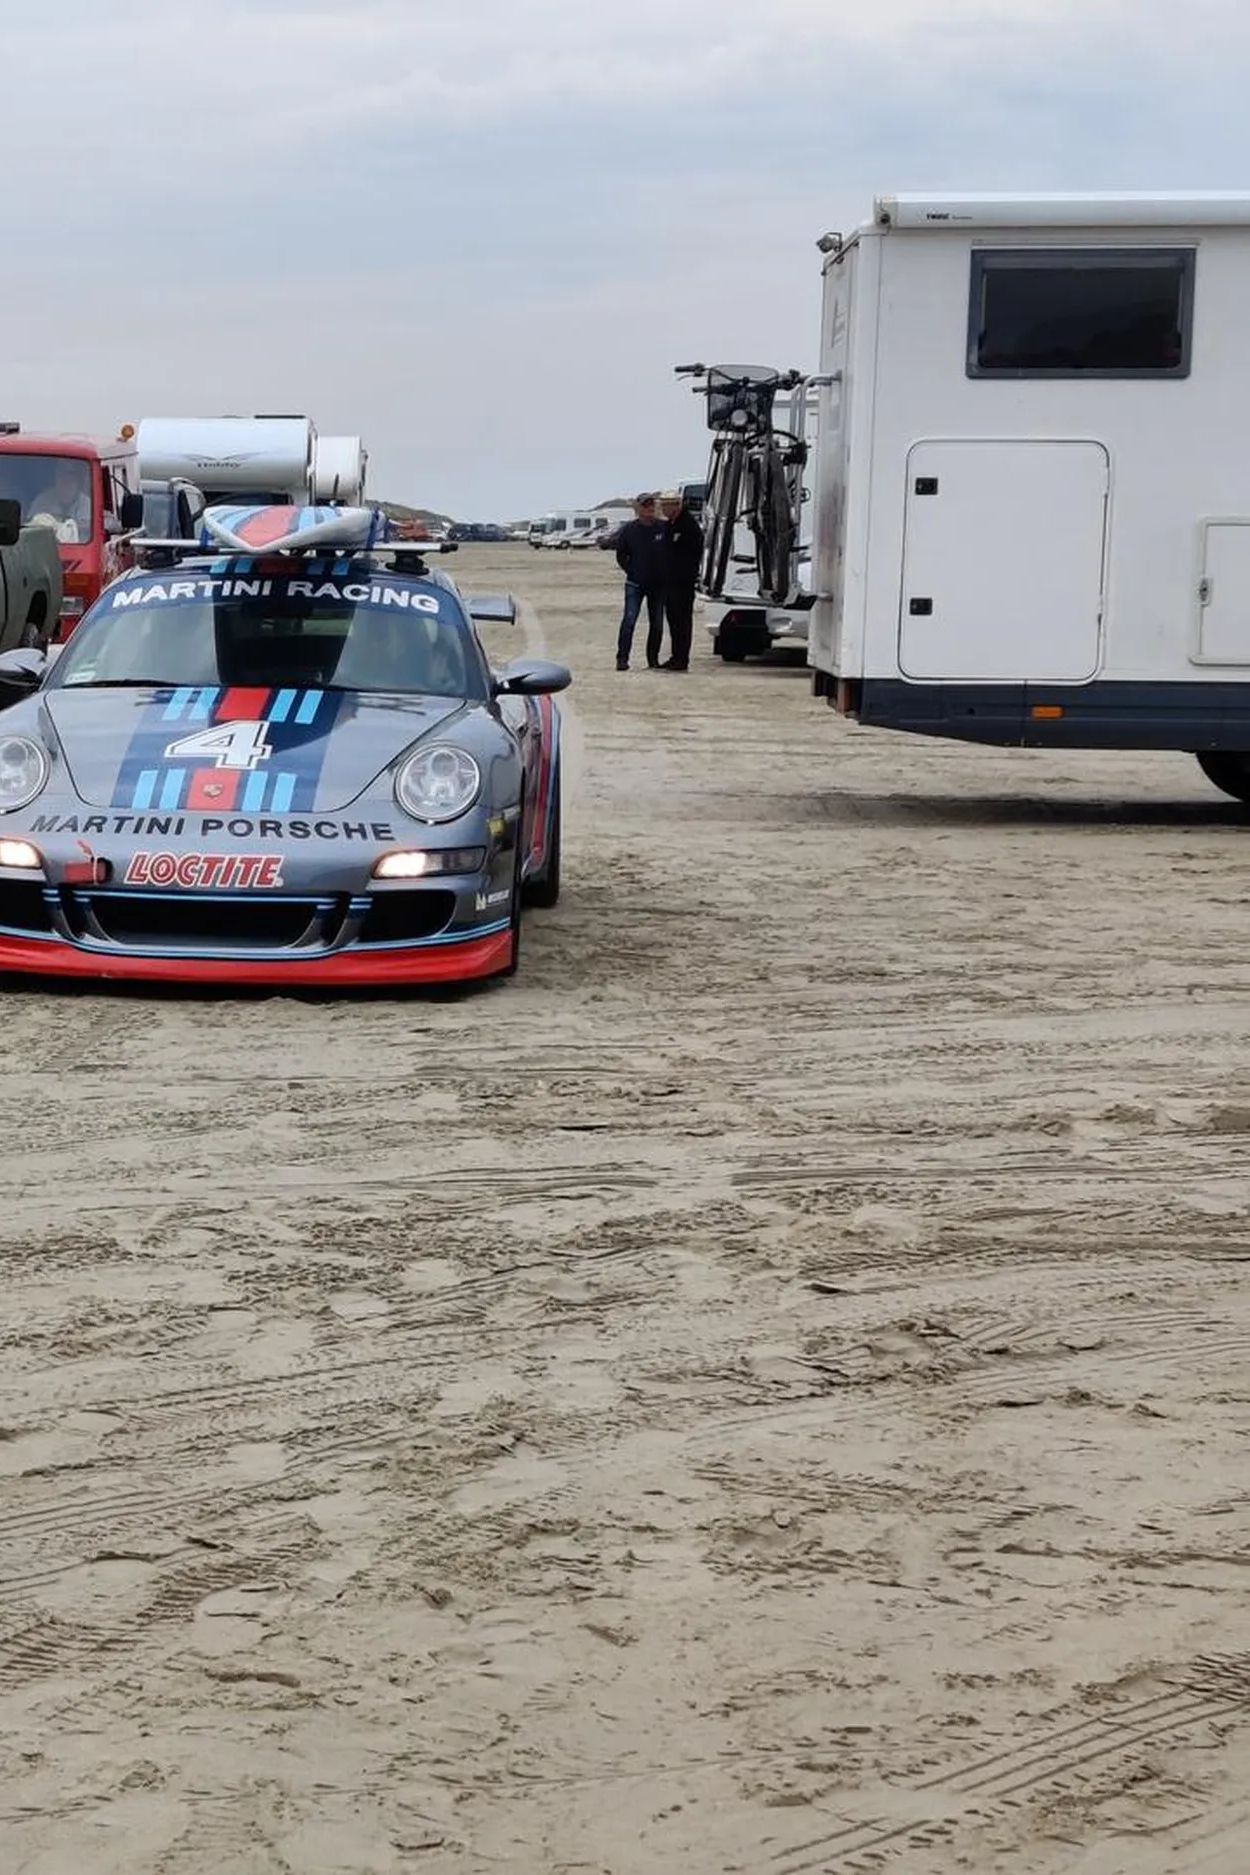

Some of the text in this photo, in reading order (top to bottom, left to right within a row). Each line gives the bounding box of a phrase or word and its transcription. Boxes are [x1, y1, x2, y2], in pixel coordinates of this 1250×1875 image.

[112, 580, 440, 614] MARTINI RACING
[164, 720, 272, 770] 4
[29, 814, 396, 842] MARTINI PORSCHE
